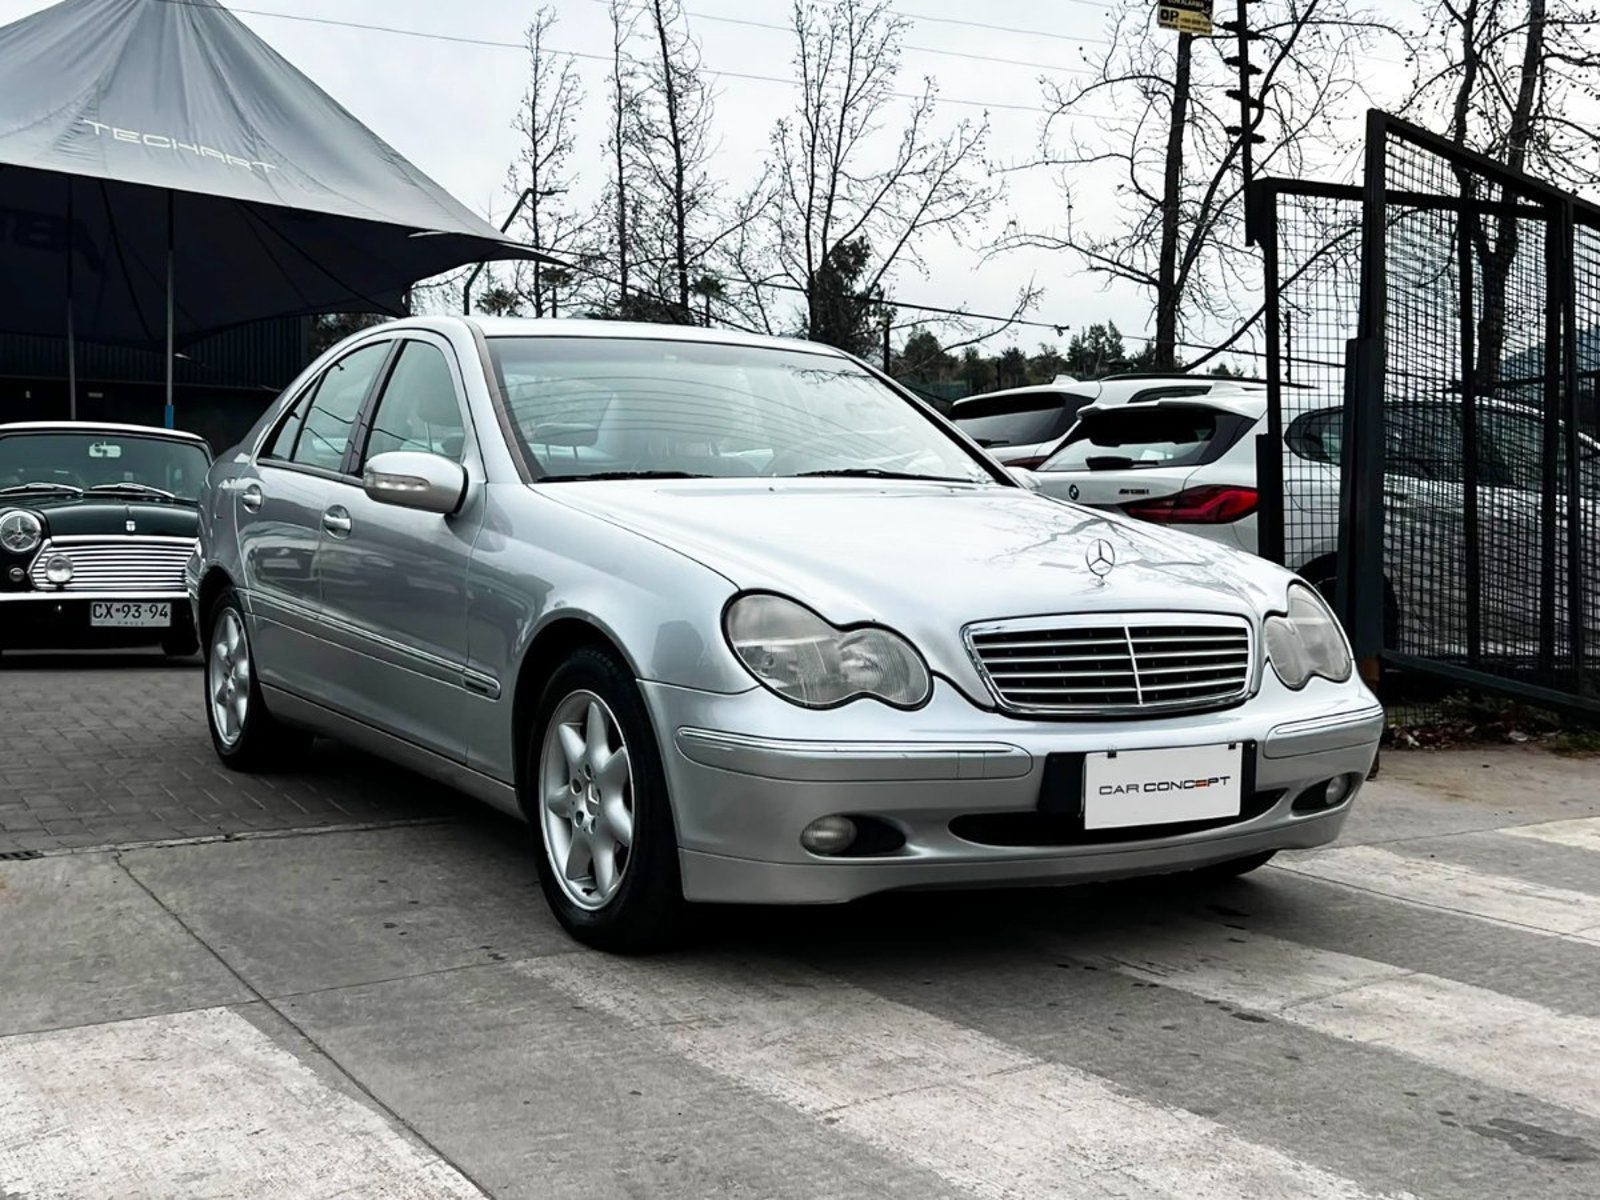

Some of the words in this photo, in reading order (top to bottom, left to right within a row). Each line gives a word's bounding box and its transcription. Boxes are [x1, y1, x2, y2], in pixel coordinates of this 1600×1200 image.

[83, 120, 277, 173] TECHART
[1099, 784, 1140, 796] CAR
[1143, 776, 1231, 793] CONCEPT
